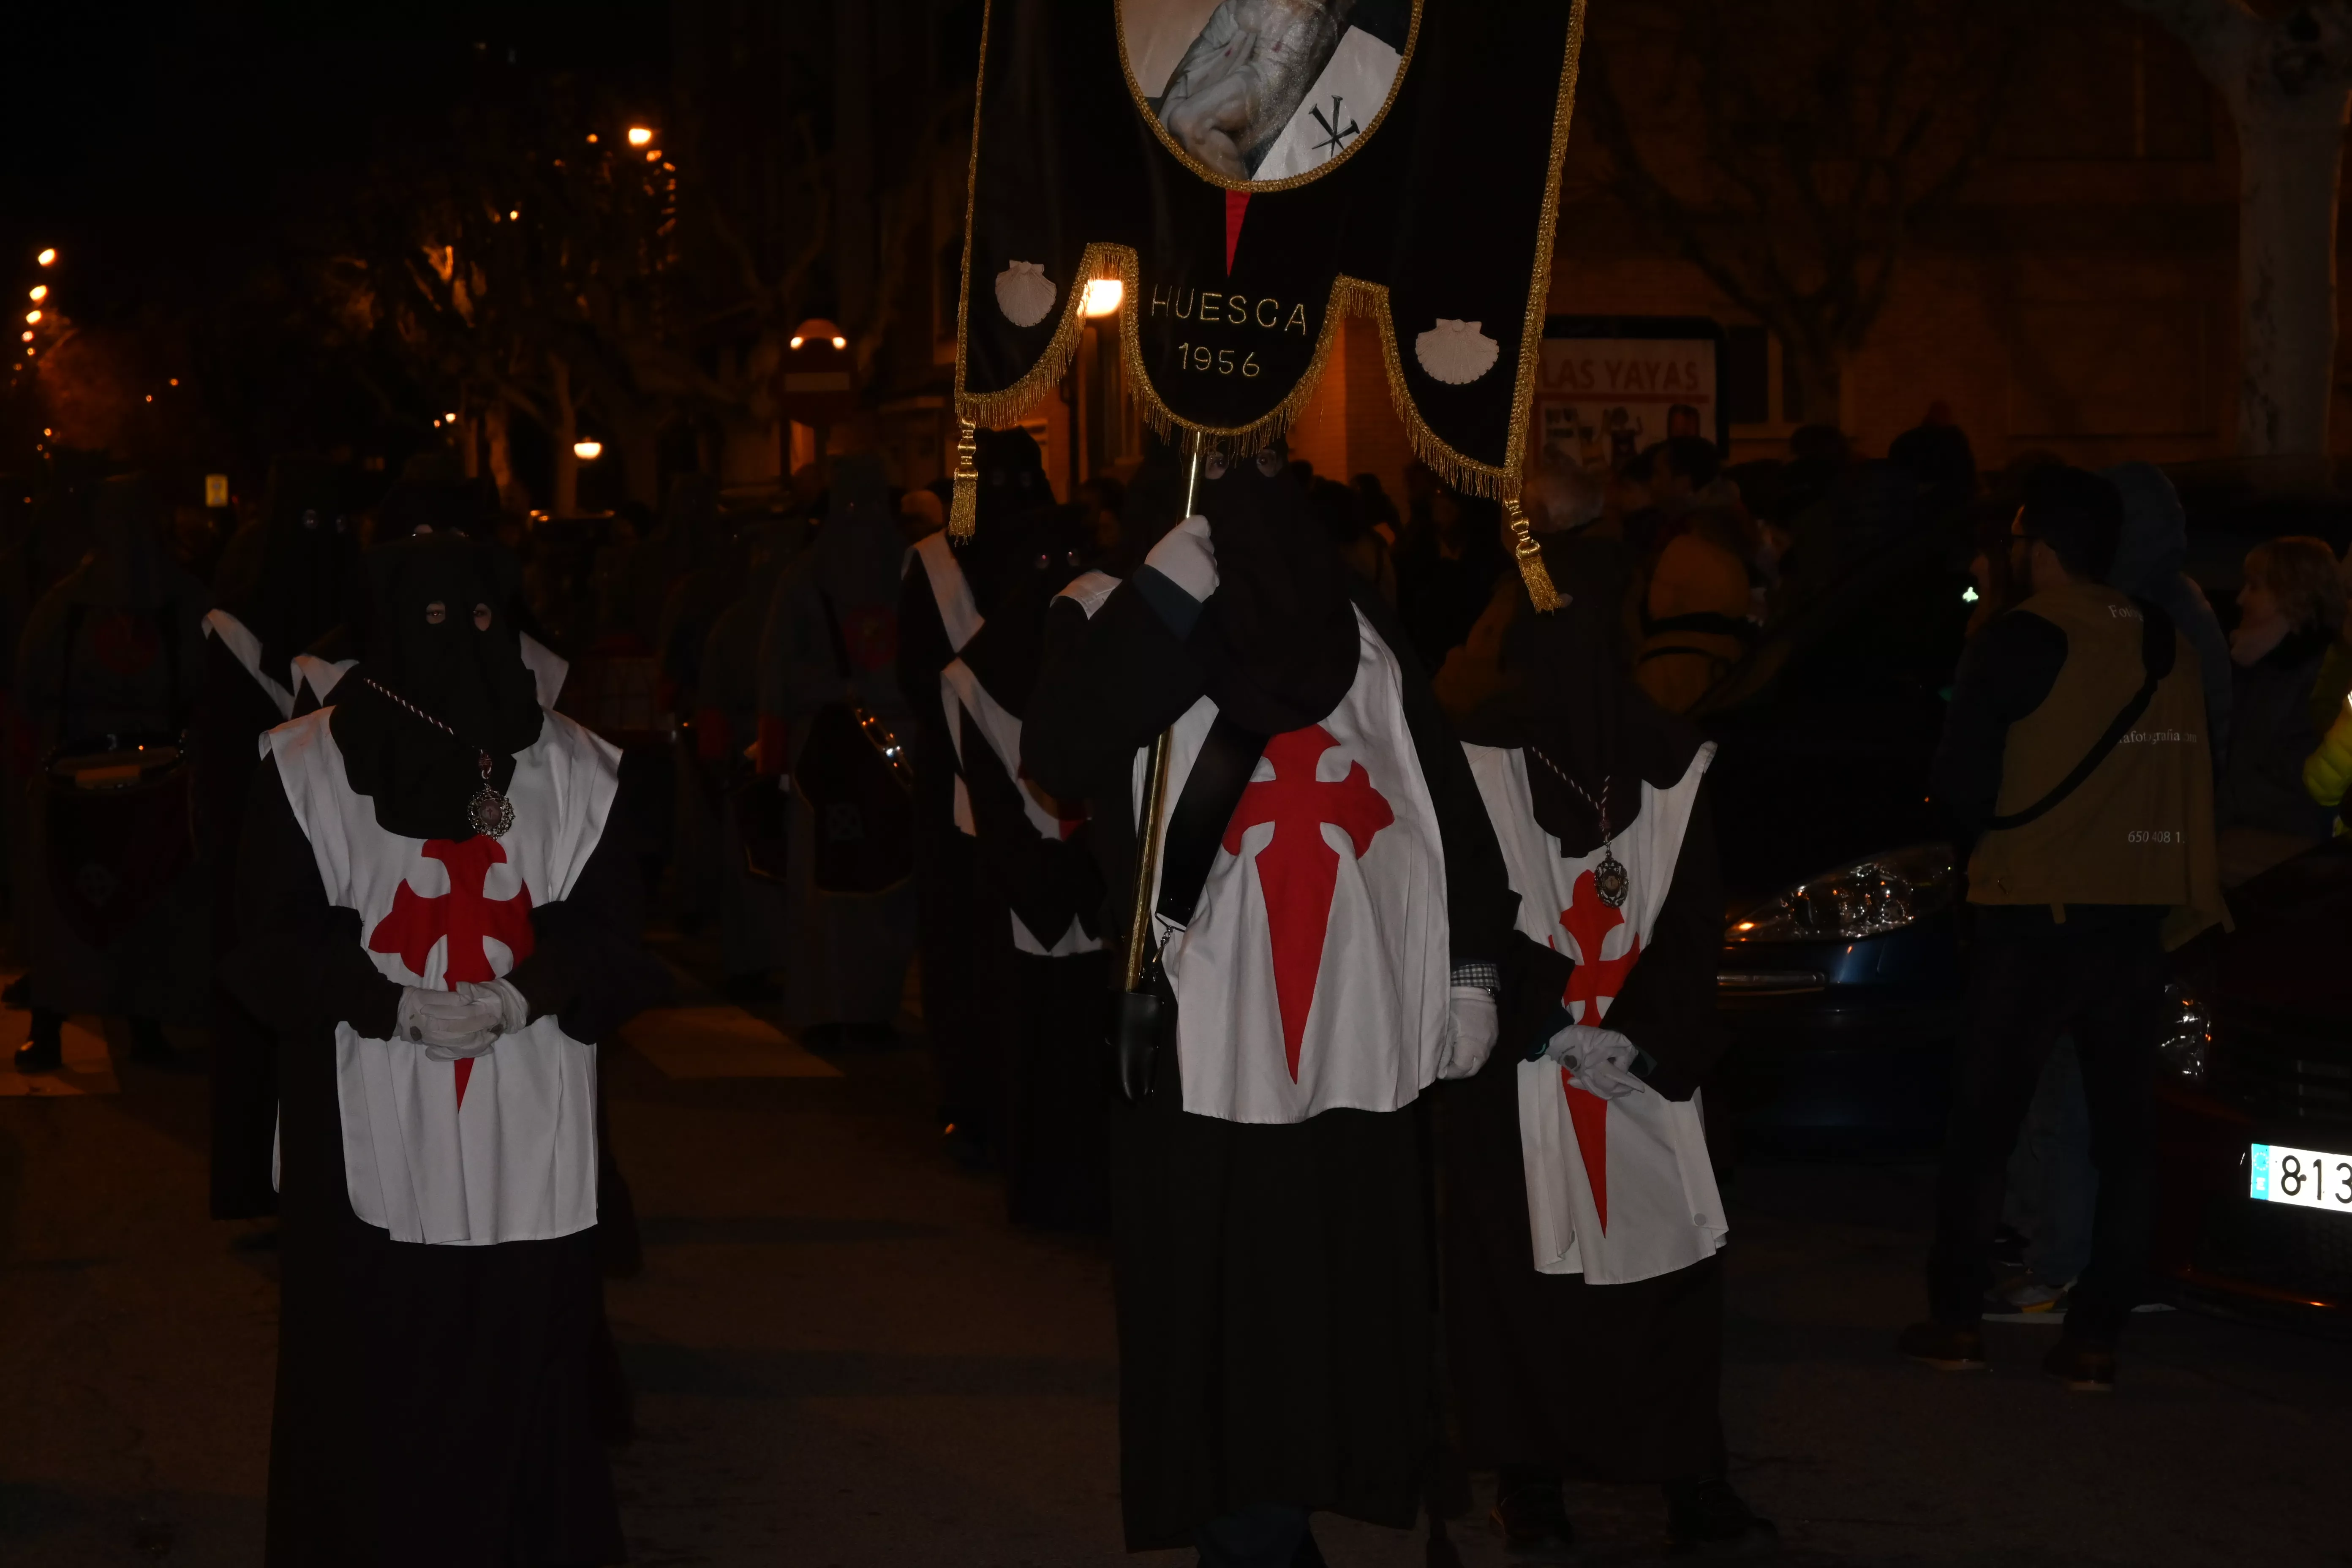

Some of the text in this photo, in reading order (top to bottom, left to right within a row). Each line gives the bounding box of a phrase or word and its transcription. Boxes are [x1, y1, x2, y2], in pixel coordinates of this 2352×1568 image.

[1152, 283, 1308, 336] HUESCA
[1178, 342, 1260, 377] 1956
[1542, 359, 1699, 391] LAS YAYAS
[2128, 830, 2150, 843] 650
[2151, 830, 2171, 843] 408
[2281, 1155, 2352, 1204] 813
